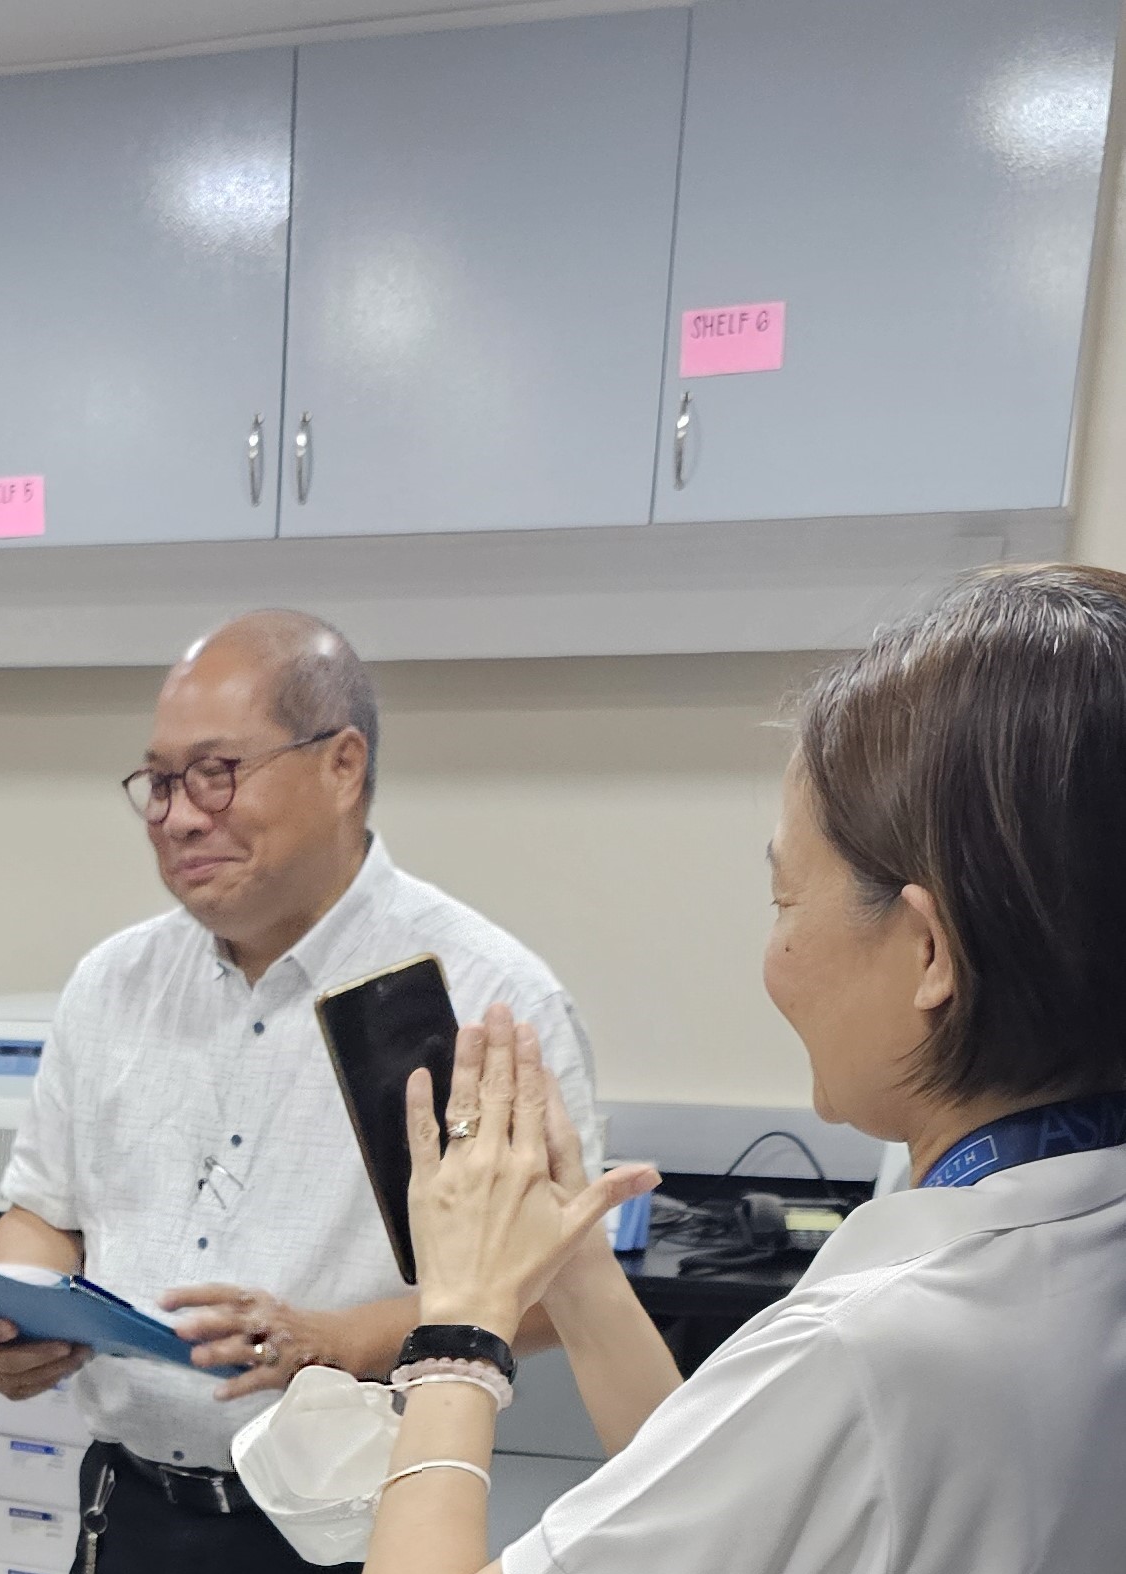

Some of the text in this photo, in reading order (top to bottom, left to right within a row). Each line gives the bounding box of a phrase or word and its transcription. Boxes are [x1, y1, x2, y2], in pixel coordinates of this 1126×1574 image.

[690, 310, 769, 339] SHELF 6
[23, 481, 34, 503] 5
[930, 1150, 977, 1187] ALTH
